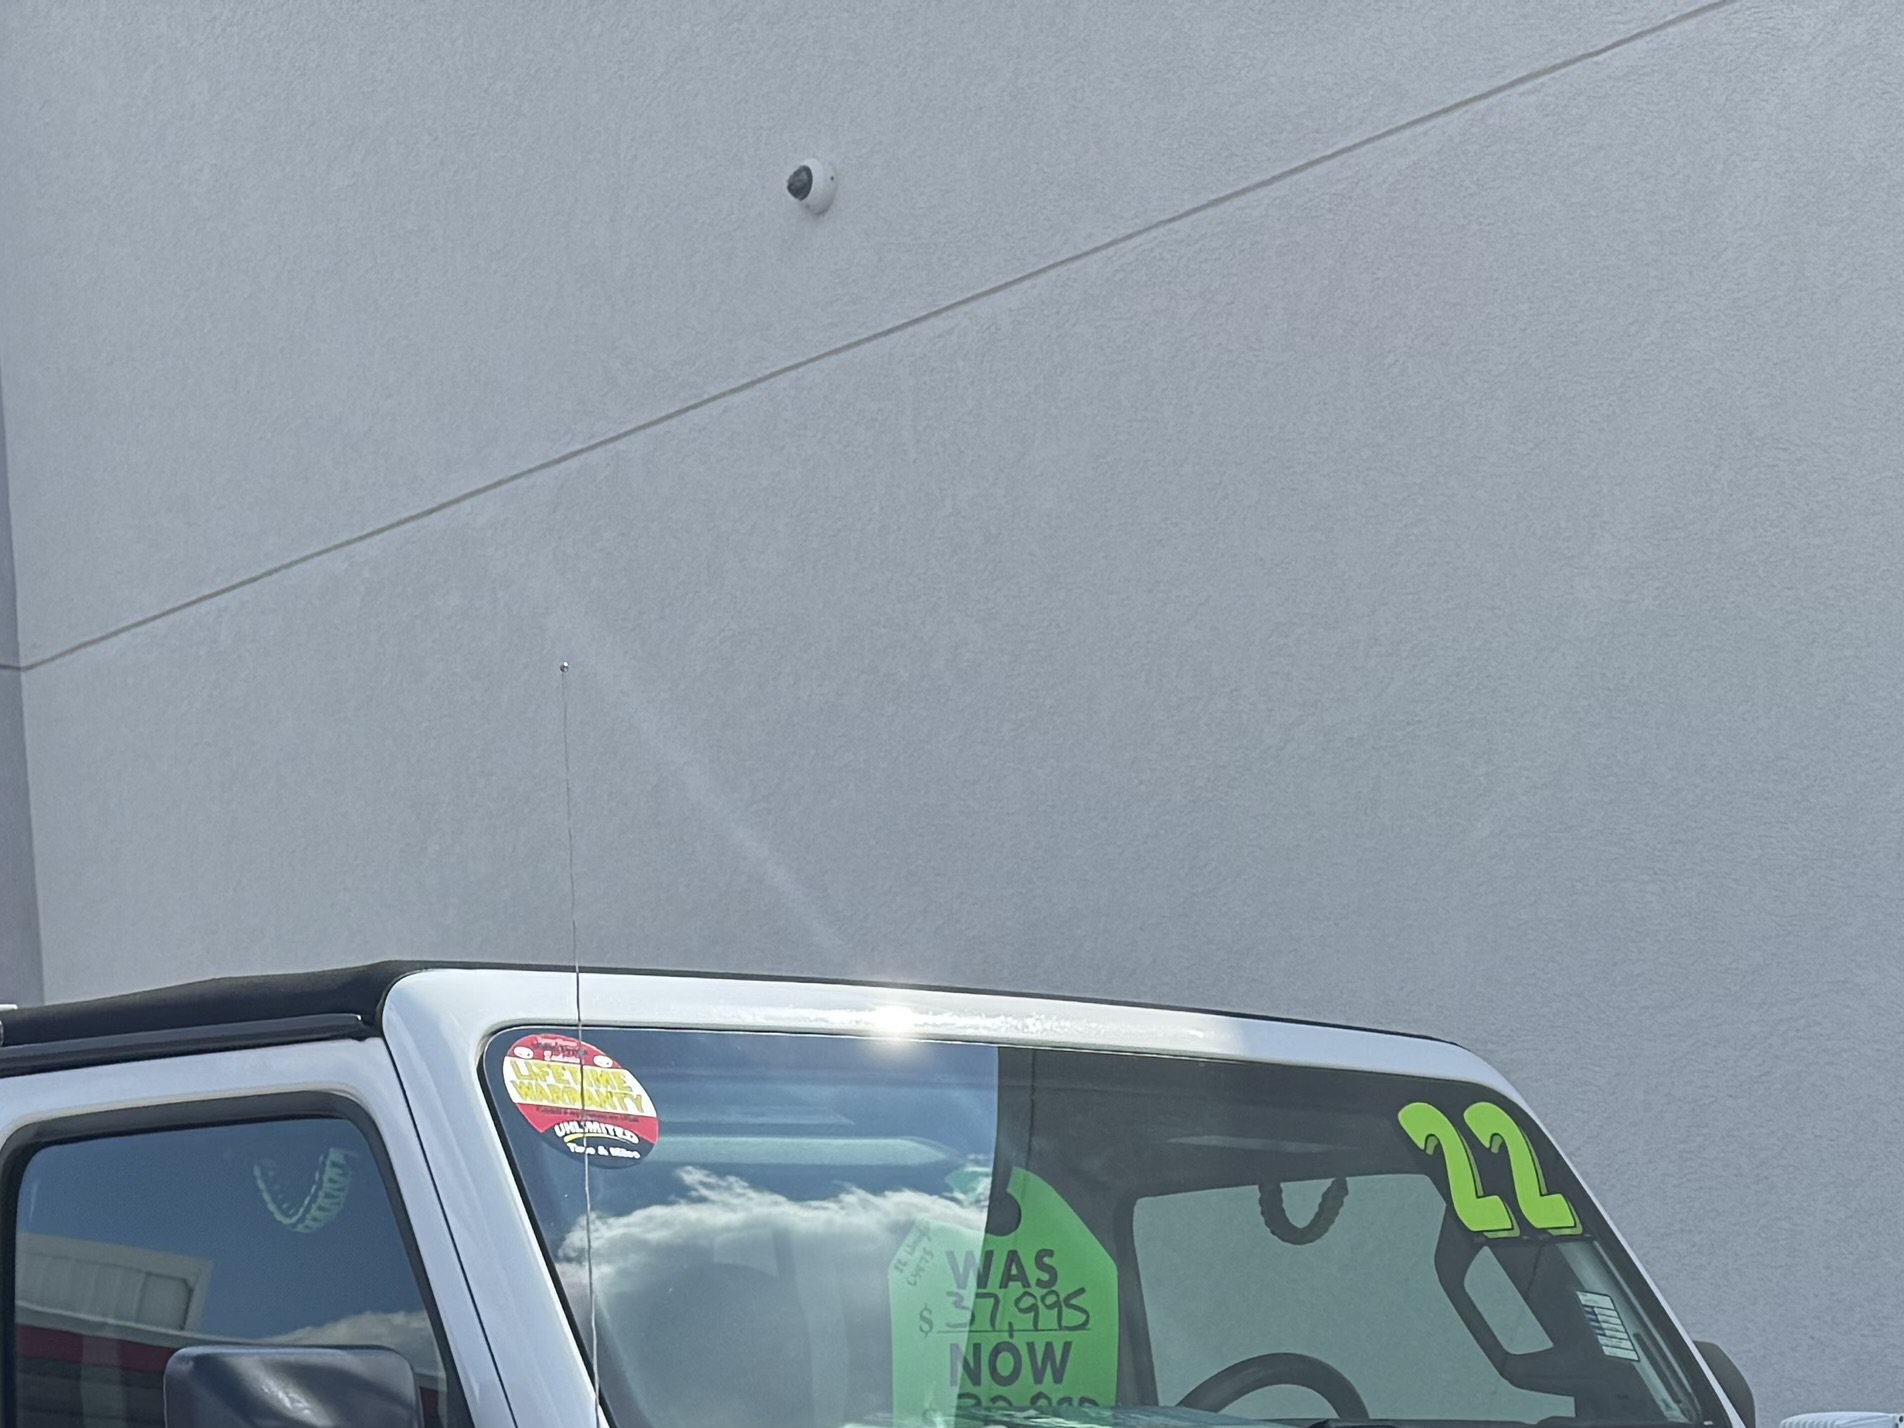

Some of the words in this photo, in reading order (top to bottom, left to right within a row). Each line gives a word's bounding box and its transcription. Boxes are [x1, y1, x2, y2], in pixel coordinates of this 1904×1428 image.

[510, 1060, 633, 1092] LIFETIME
[509, 1079, 645, 1113] WARRANTY
[1398, 1101, 1583, 1238] 22
[945, 1249, 1059, 1290] WAS
[919, 1304, 935, 1338] $
[949, 1340, 1074, 1388] NOW
